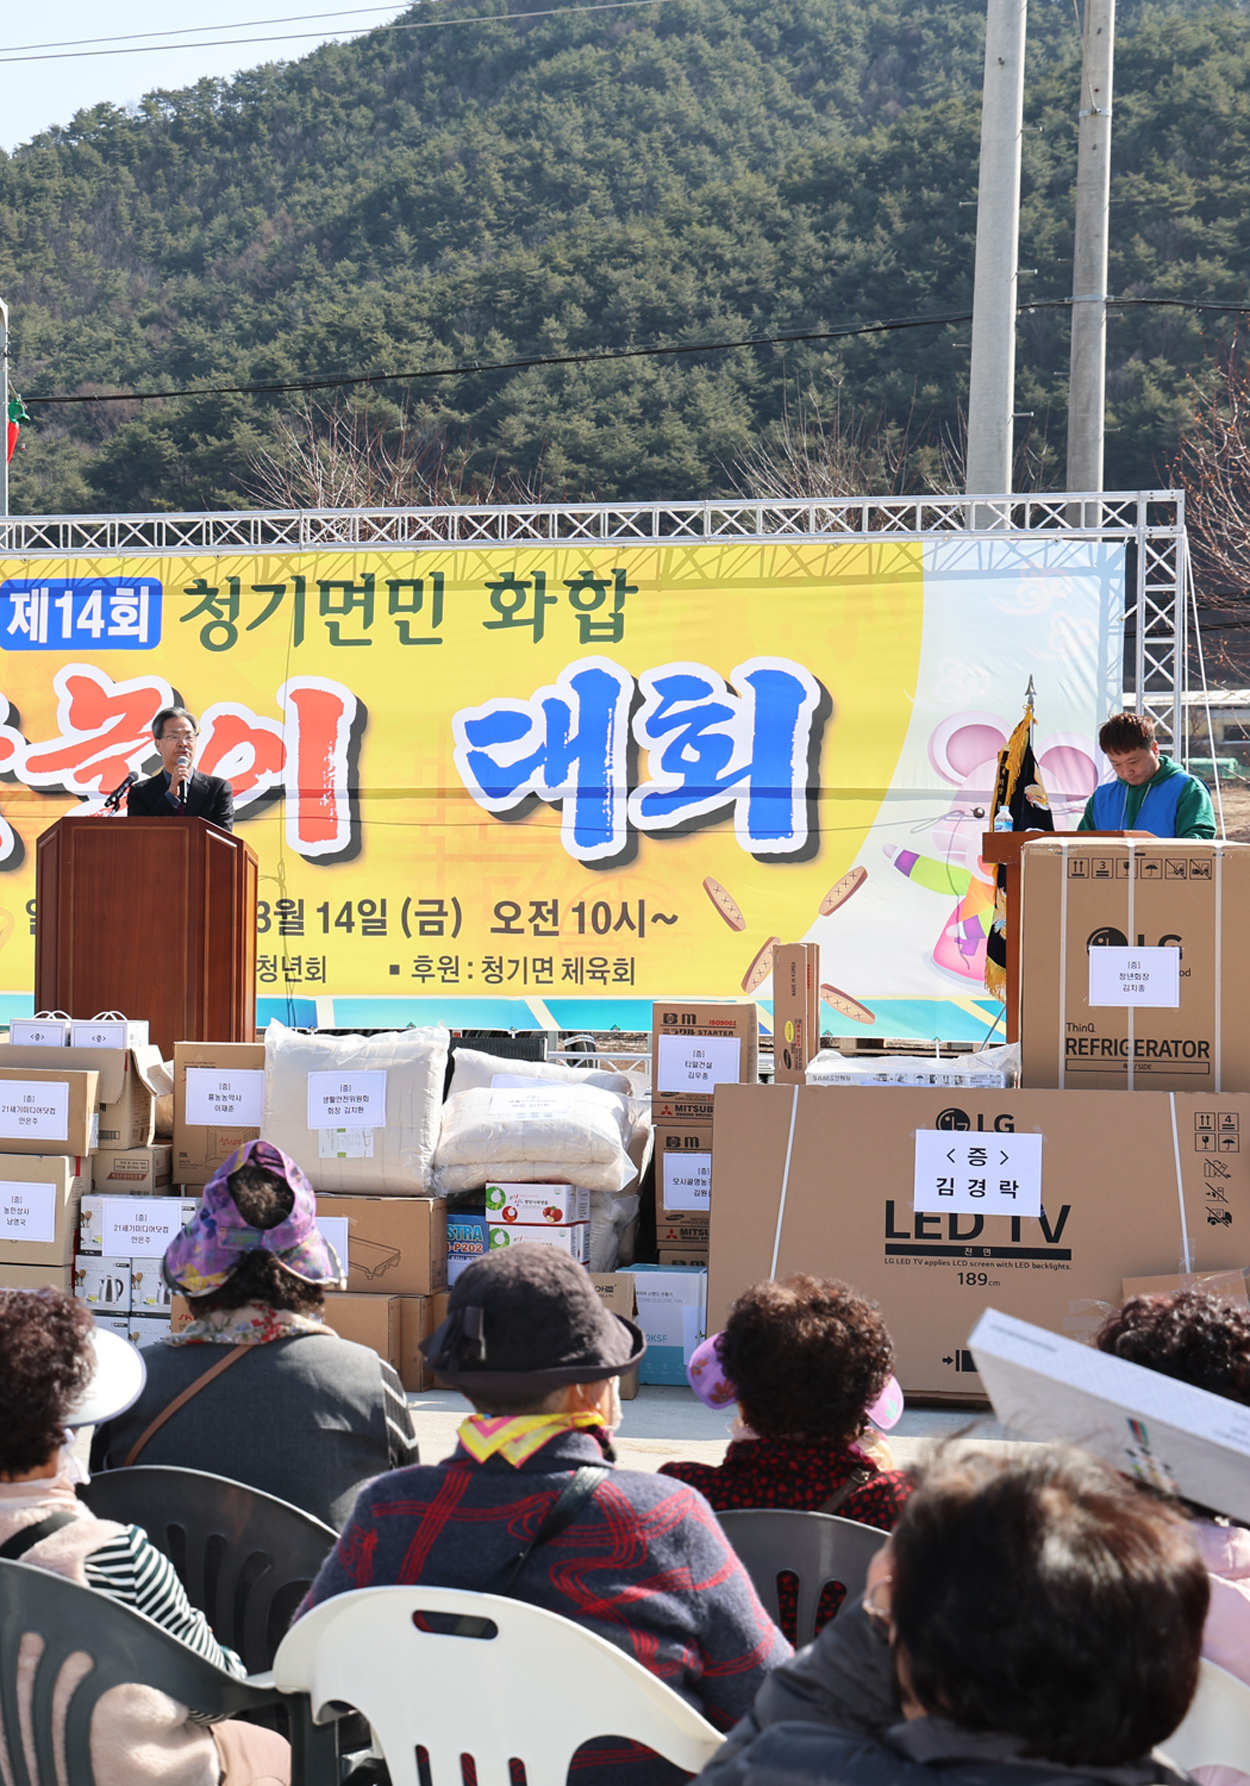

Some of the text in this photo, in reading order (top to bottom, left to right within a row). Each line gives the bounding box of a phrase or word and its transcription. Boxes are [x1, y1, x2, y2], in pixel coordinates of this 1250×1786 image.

[6, 567, 637, 652] 제14회 청기면민 화합
[464, 666, 807, 860] 대회
[317, 898, 388, 935] 14일
[401, 897, 461, 937] (금)
[489, 900, 560, 935] 오전
[577, 899, 678, 936] 10시~
[257, 954, 327, 984] 청년회
[411, 955, 460, 984] 후원
[481, 955, 554, 985] 청기면
[561, 954, 635, 986] 체육회
[1119, 973, 1149, 981] 청년회장
[698, 1029, 734, 1037] STARTER
[1066, 1023, 1095, 1033] ThinQ
[1065, 1038, 1210, 1059] REFRIGERATOR
[684, 1060, 713, 1069] 티알건설
[323, 1095, 370, 1104] 생활안전위원회
[1, 1105, 56, 1115] 21세기미디어닷컴
[327, 1107, 341, 1115] 회장
[977, 1113, 1015, 1133] LG
[885, 1200, 1072, 1243] LED TV
[113, 1224, 169, 1234] 21세기미디어닷컴
[1032, 1262, 1072, 1270] backlights.
